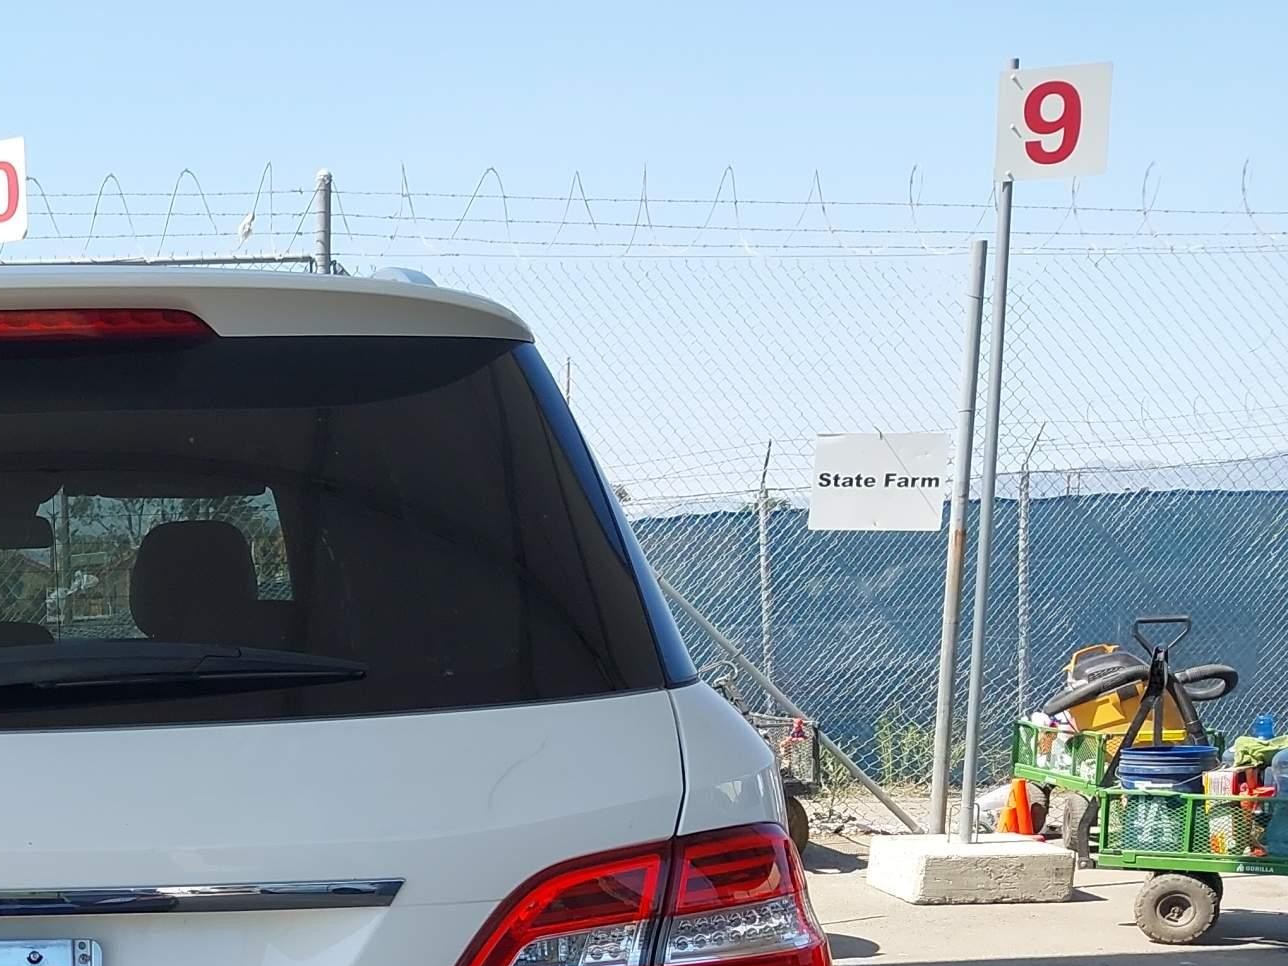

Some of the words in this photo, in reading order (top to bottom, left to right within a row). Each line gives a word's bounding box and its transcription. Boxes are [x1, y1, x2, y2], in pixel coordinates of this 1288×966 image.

[1024, 81, 1081, 164] 9
[818, 472, 876, 488] State
[884, 473, 940, 488] Farm
